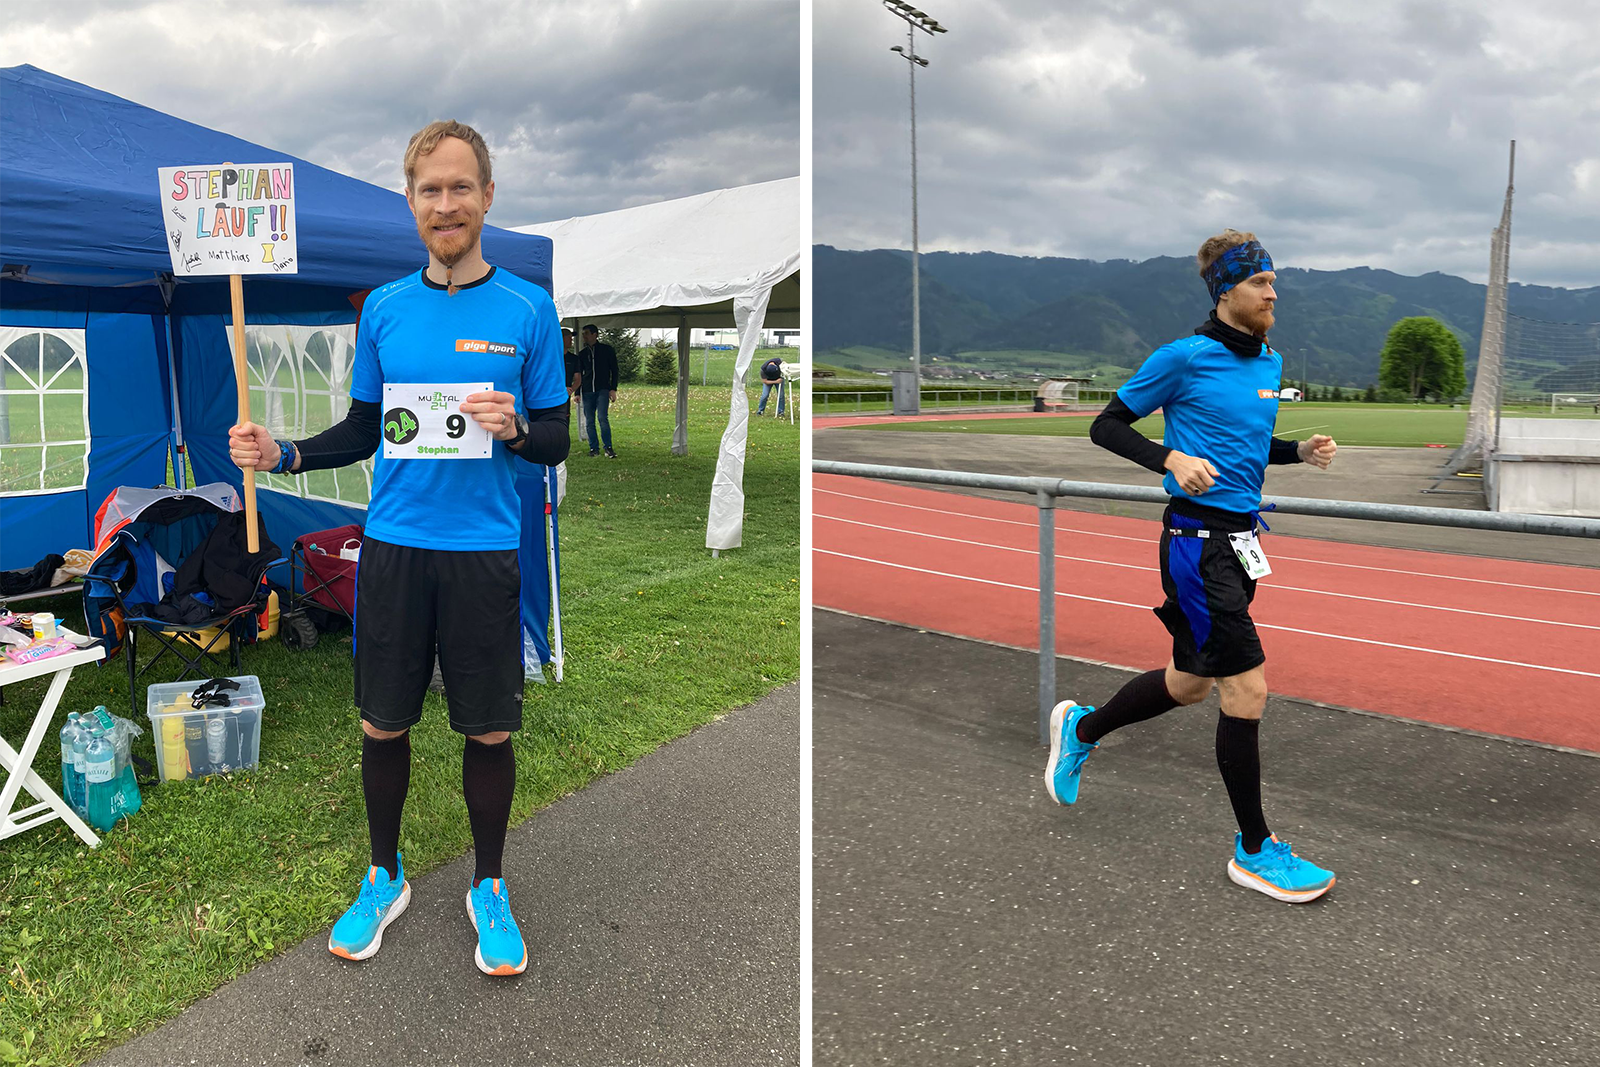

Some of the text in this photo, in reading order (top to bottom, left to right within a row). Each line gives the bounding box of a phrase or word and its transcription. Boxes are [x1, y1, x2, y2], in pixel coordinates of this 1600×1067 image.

[172, 169, 291, 201] STEPHAN
[208, 250, 250, 262] Matthias
[463, 341, 515, 354] giga sport
[430, 402, 447, 410] 24
[385, 411, 417, 442] 24
[446, 414, 466, 439] 9
[417, 446, 459, 455] Stephan
[1250, 550, 1260, 563] 9
